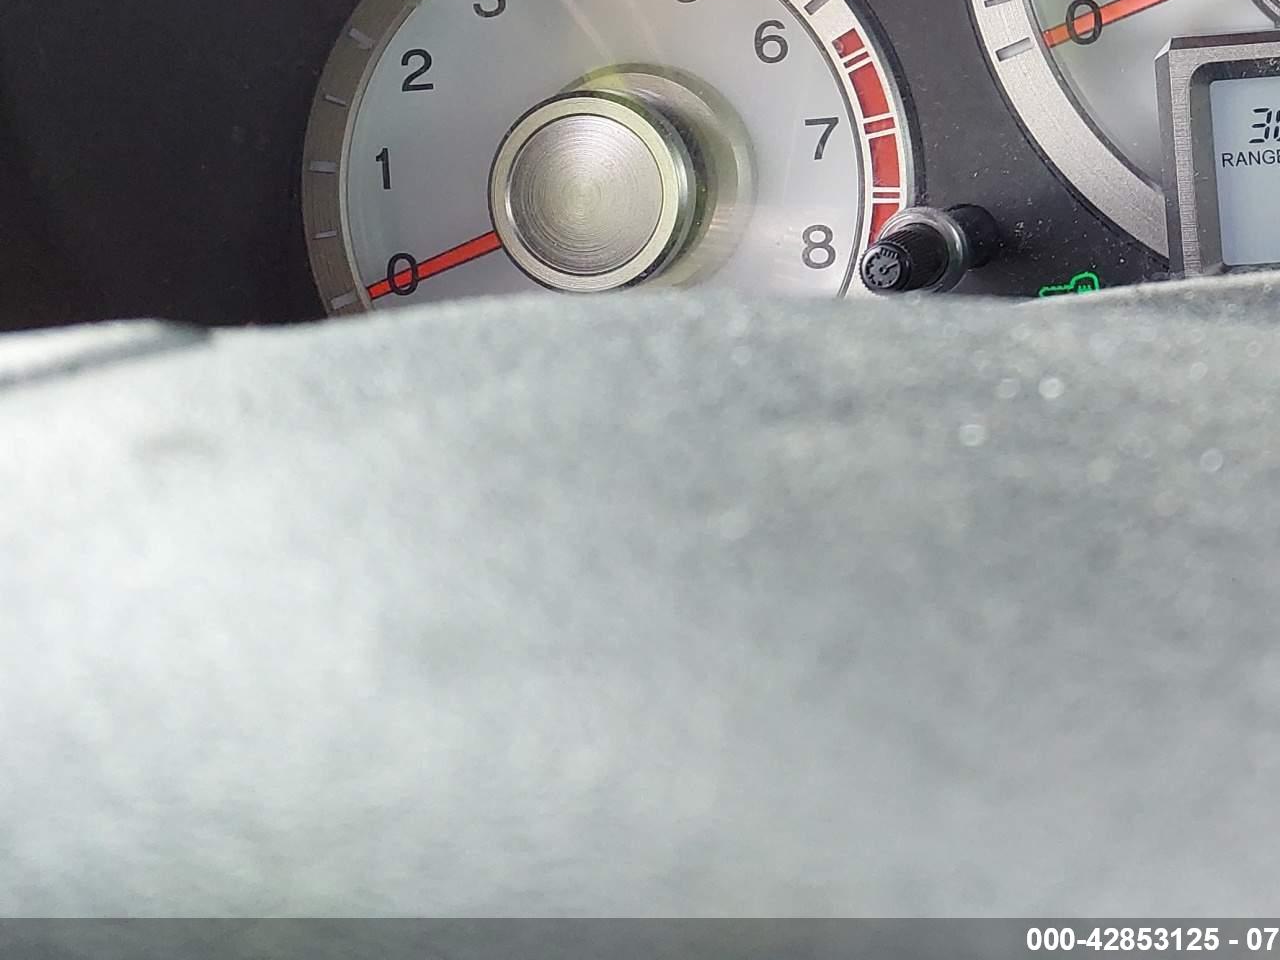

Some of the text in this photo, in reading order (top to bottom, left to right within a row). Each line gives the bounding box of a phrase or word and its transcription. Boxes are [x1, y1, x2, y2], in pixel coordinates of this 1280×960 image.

[754, 20, 789, 63] 6
[401, 49, 434, 92] 2
[805, 117, 838, 160] 7
[375, 147, 391, 189] 1
[802, 225, 835, 268] 8
[387, 253, 418, 294] 0
